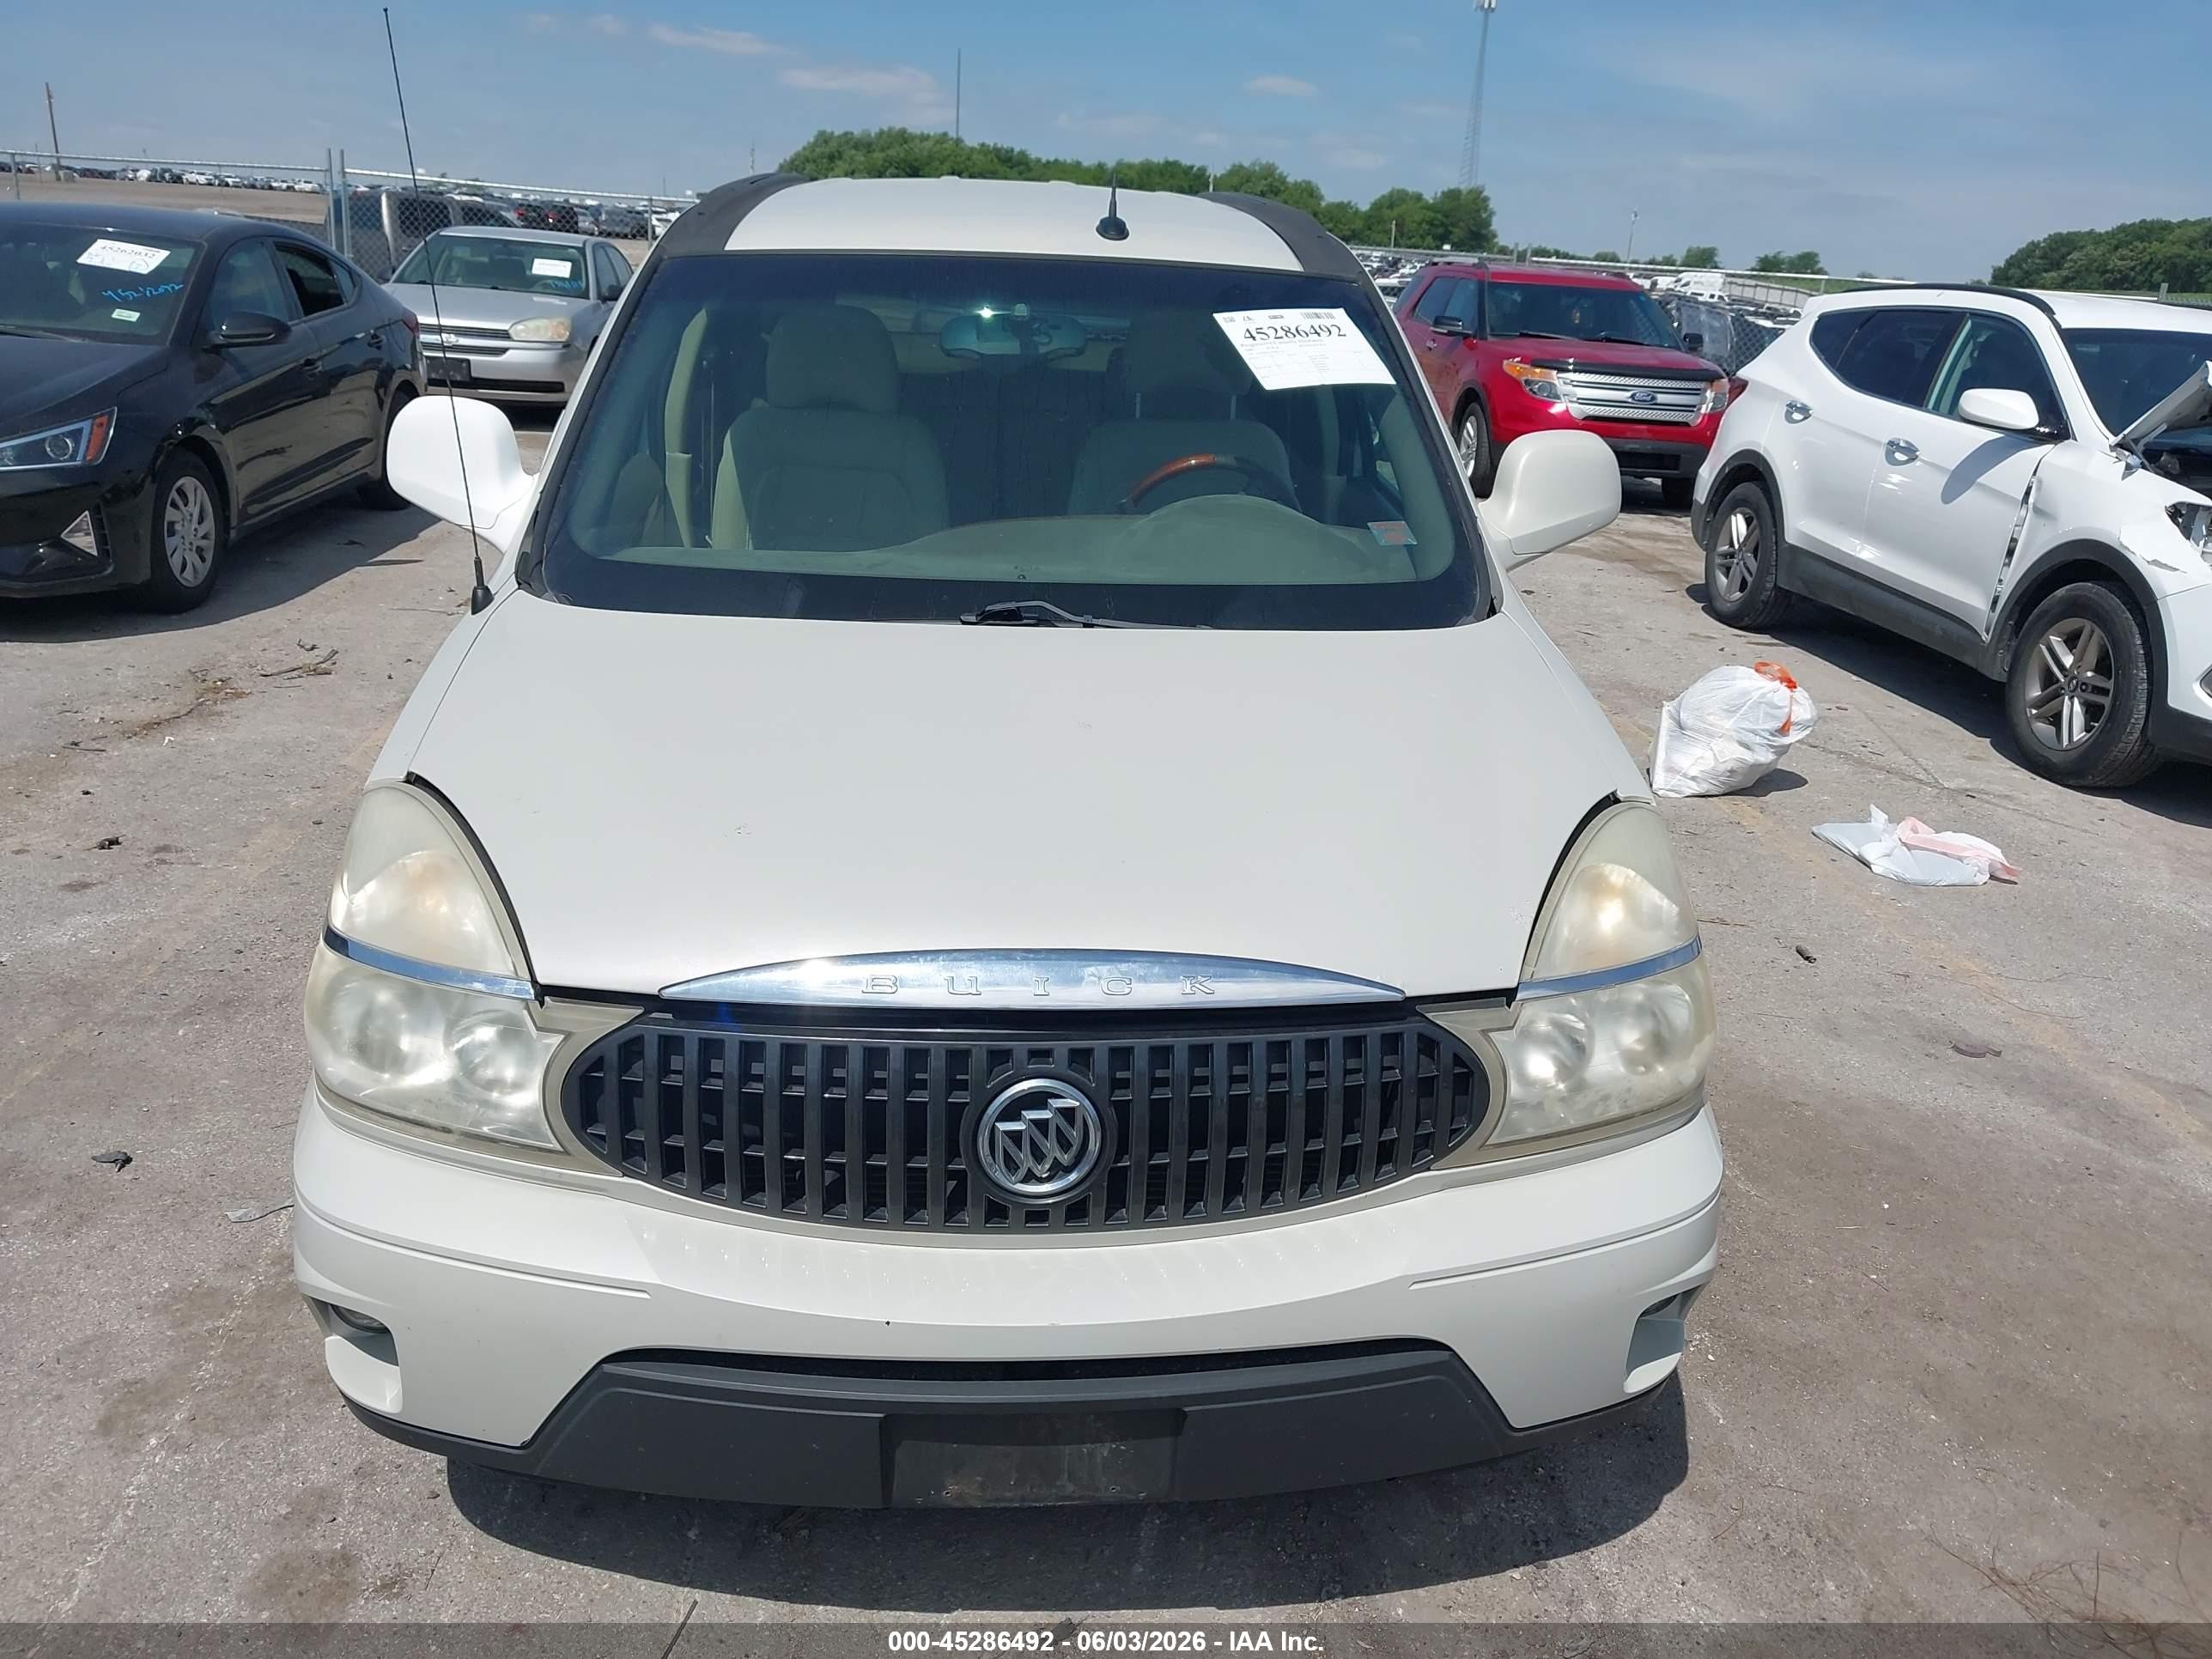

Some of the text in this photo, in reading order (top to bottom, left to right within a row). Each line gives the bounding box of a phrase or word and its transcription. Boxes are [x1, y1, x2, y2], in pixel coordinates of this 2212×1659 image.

[1243, 323, 1347, 342] 45286492
[1634, 391, 1653, 401] Ford
[860, 974, 1216, 997] BUICK
